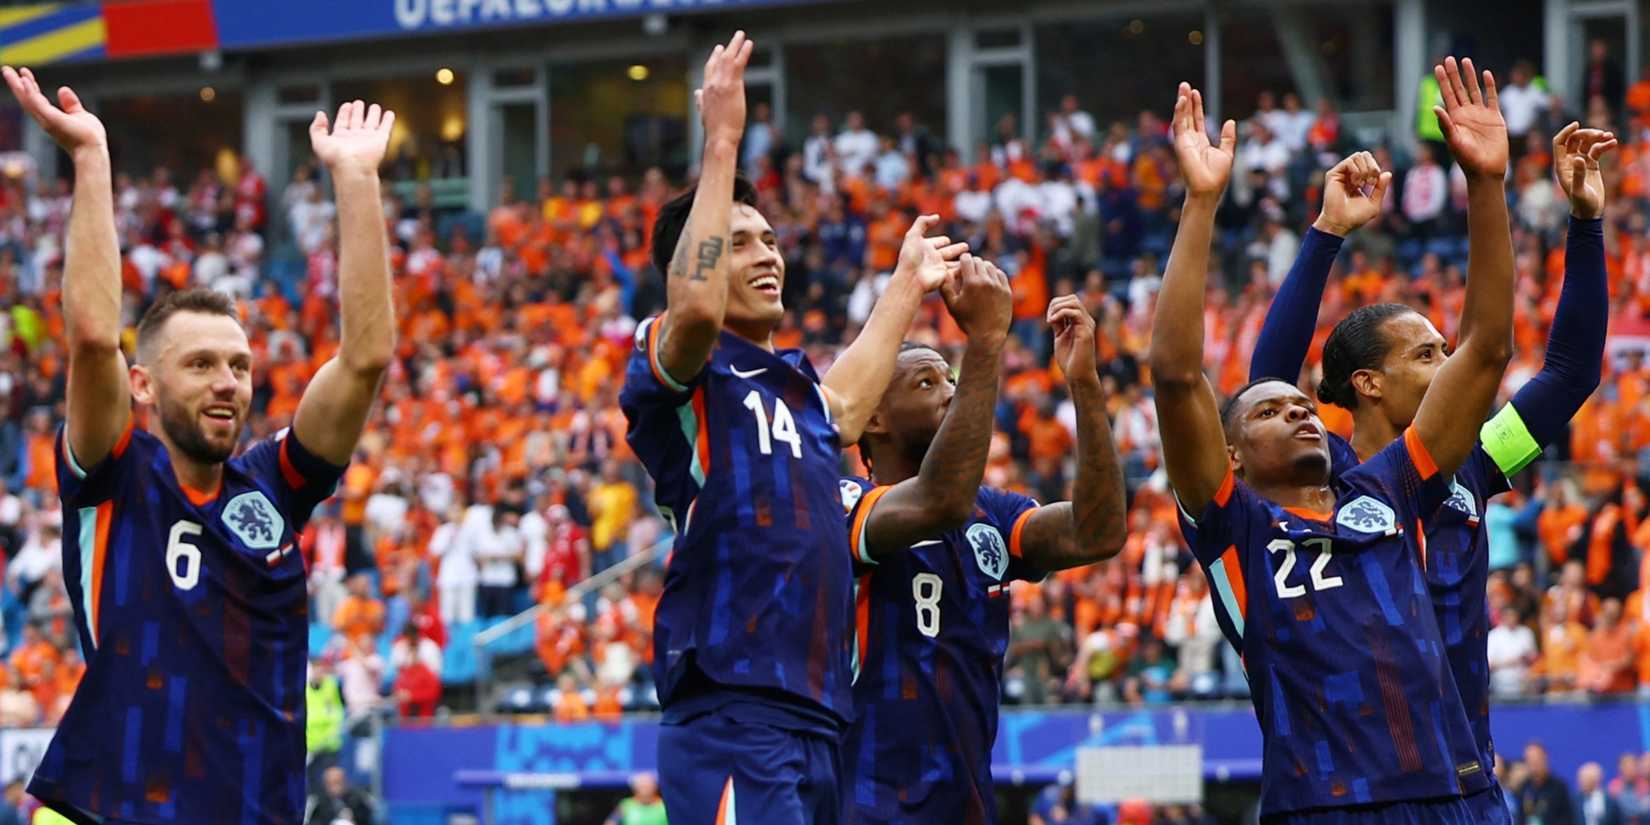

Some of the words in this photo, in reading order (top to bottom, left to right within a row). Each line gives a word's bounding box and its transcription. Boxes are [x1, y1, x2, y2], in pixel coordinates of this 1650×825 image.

[743, 389, 802, 459] 14
[165, 519, 201, 590] 6
[1267, 538, 1343, 598] 22
[912, 572, 942, 637] 8
